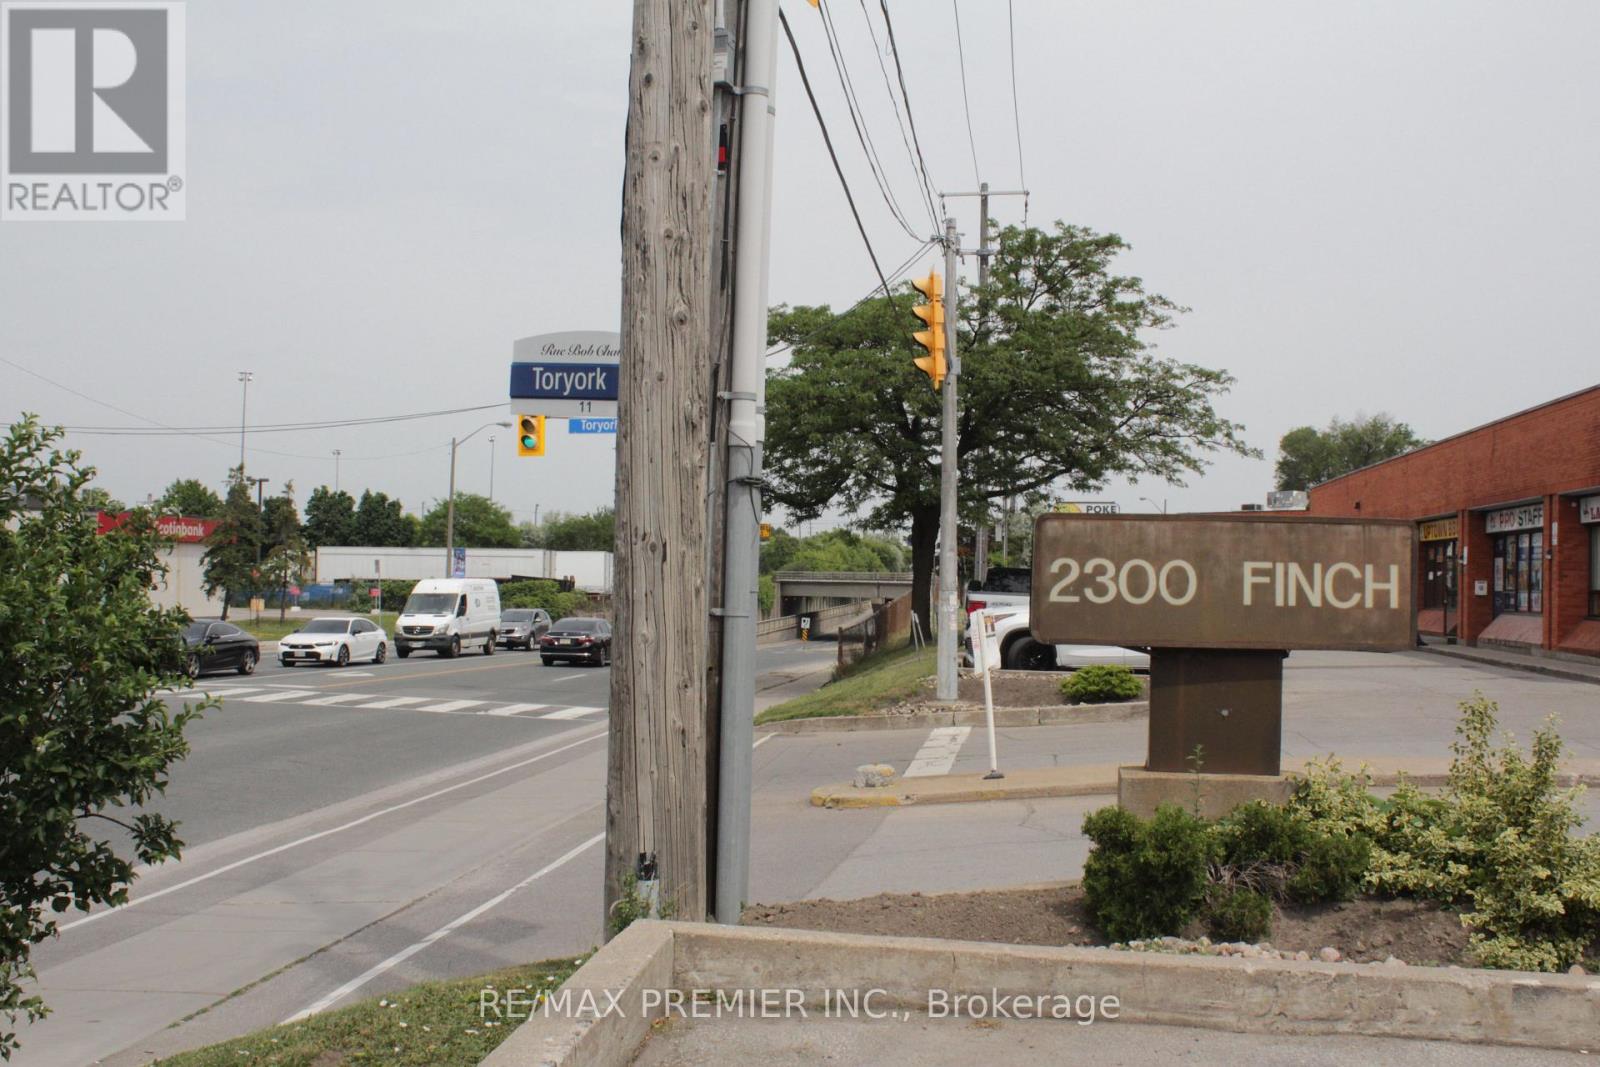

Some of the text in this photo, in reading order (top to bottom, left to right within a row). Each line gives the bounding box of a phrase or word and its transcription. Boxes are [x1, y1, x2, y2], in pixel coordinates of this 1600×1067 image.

[541, 343, 566, 357] Rue
[567, 343, 594, 357] Bob
[532, 366, 607, 396] Toryork
[579, 401, 592, 413] 11
[1086, 505, 1117, 513] POKE
[1518, 506, 1543, 526] STAFF
[1048, 557, 1399, 609] 2300 FINCH
